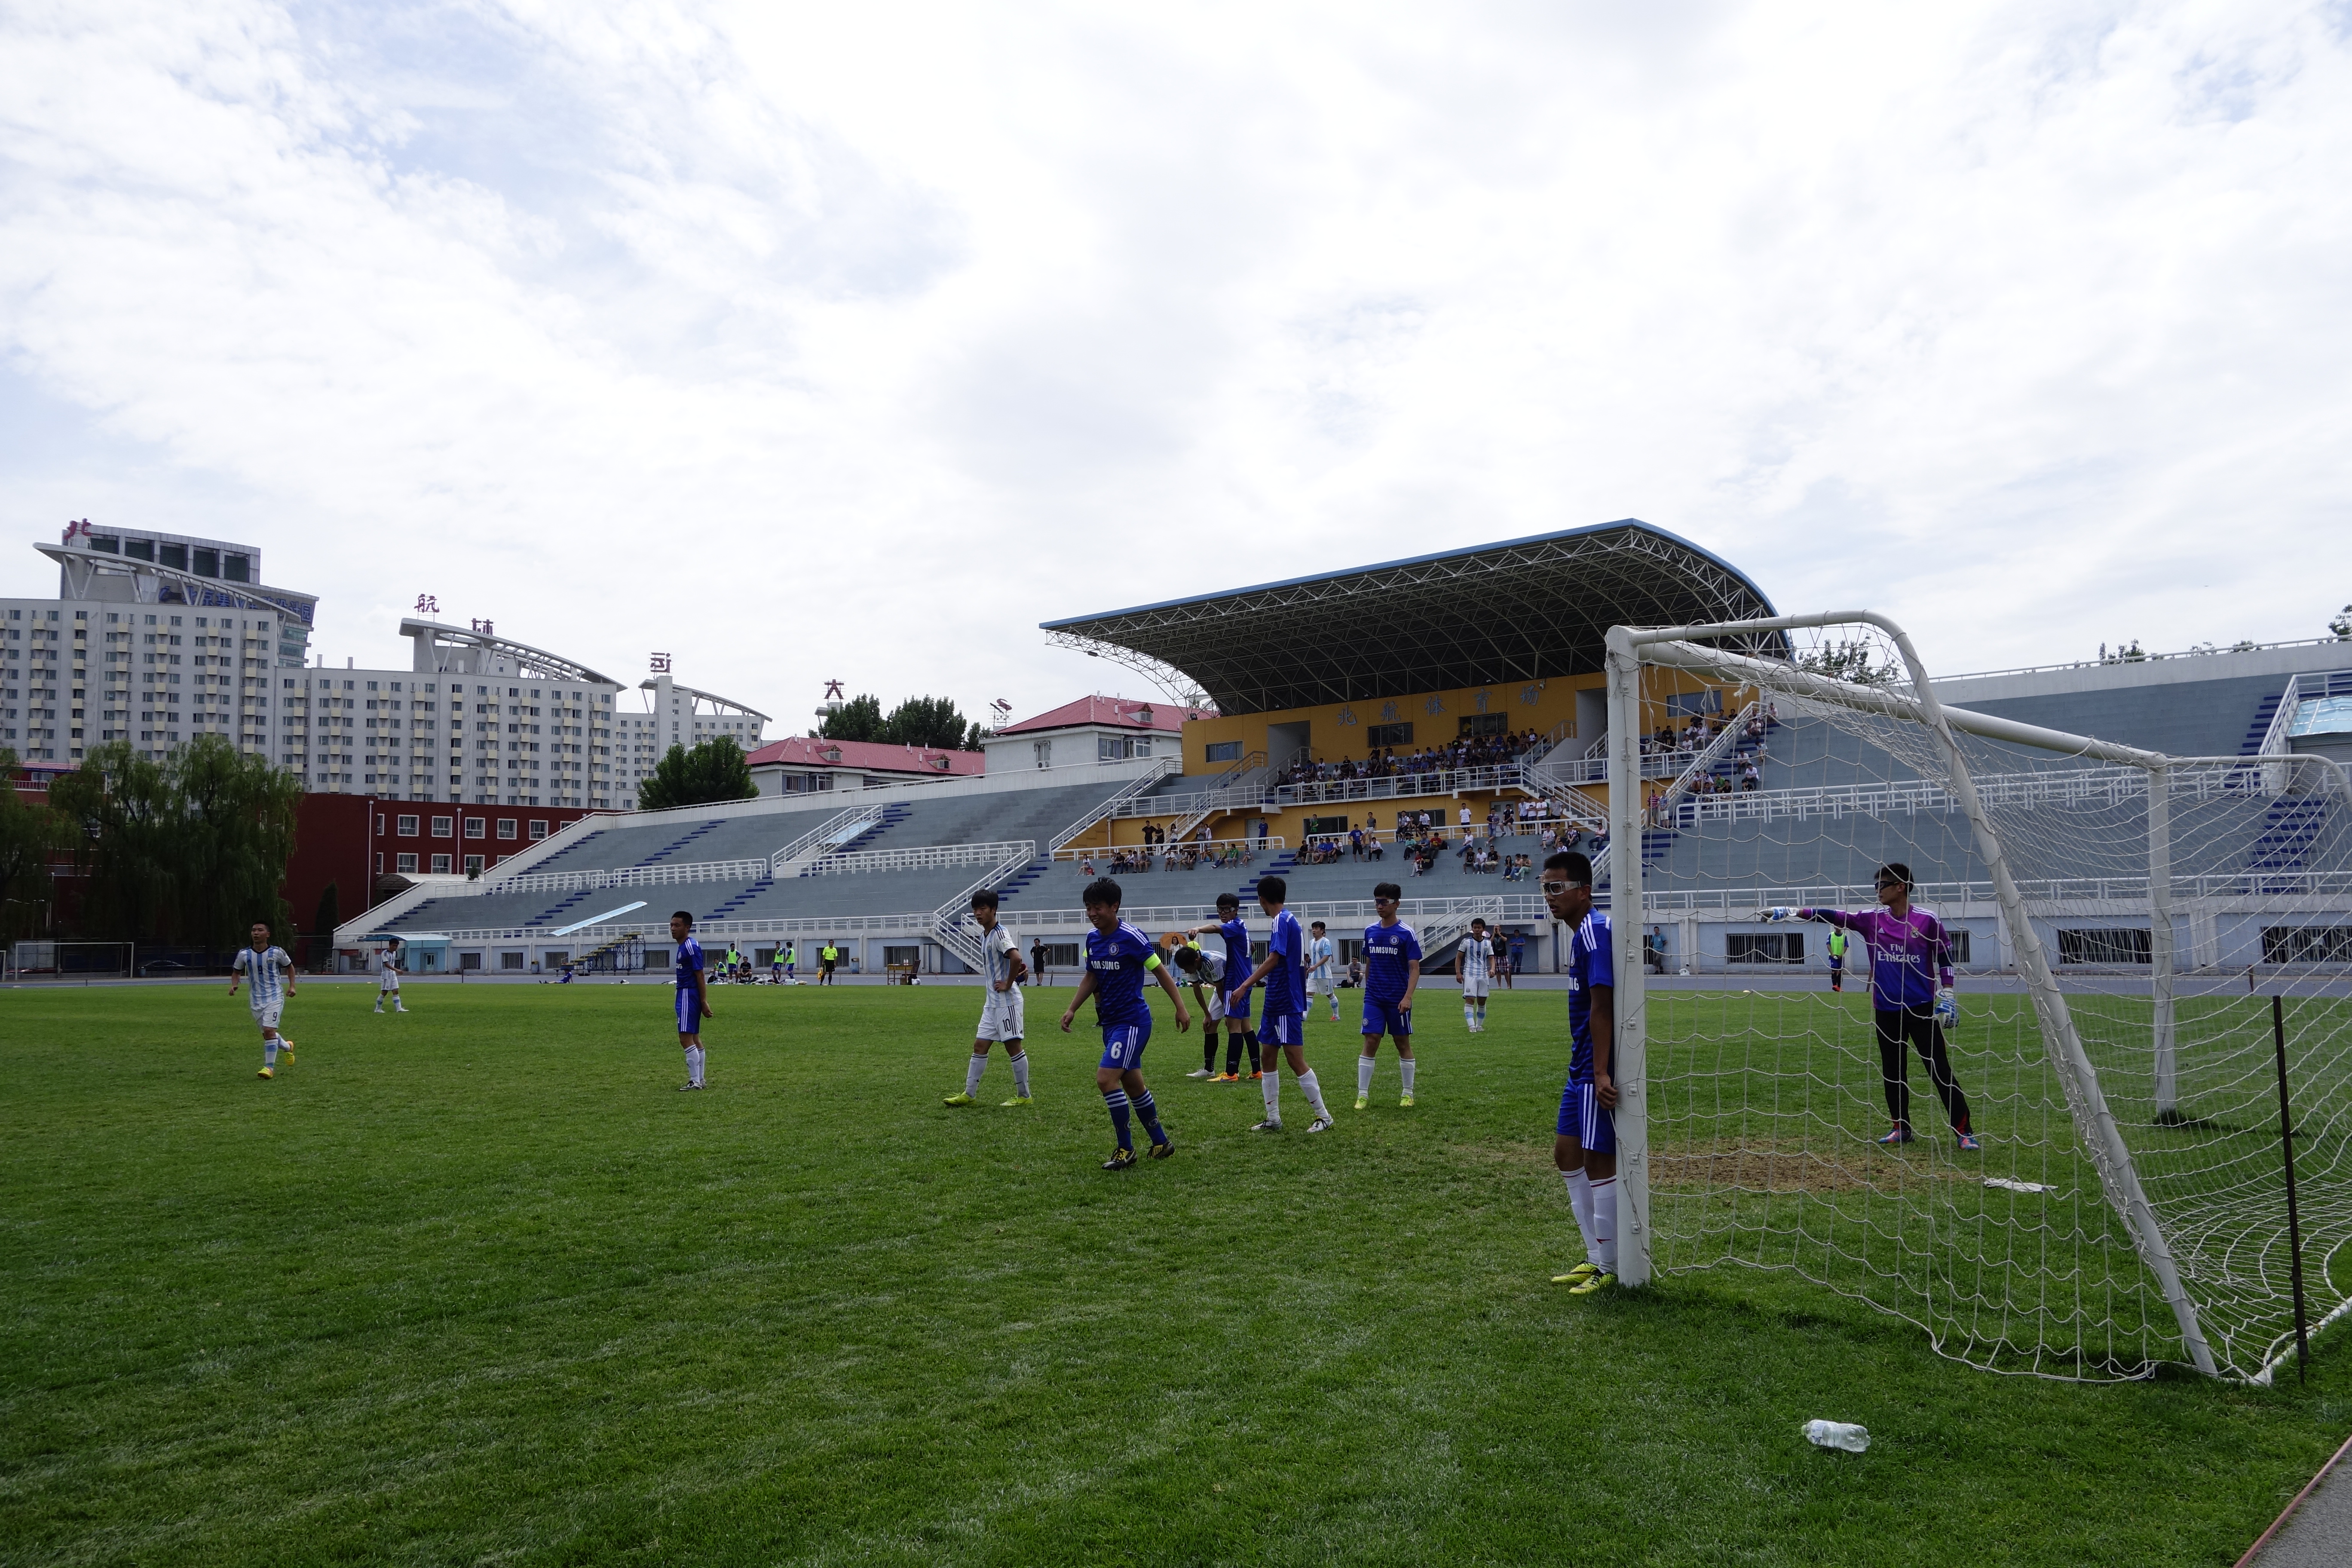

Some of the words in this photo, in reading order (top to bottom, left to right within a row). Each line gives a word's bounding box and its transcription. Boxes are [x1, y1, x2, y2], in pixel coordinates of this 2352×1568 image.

[414, 594, 440, 613] 航
[1337, 684, 1540, 726] 北航体育场
[1369, 946, 1398, 955] SAMSUNG
[1890, 943, 1904, 953] Fly
[1877, 951, 1920, 963] Emirates
[258, 965, 263, 974] 9
[272, 1012, 278, 1021] 9
[1002, 1018, 1011, 1032] 10
[1110, 1041, 1123, 1059] 6
